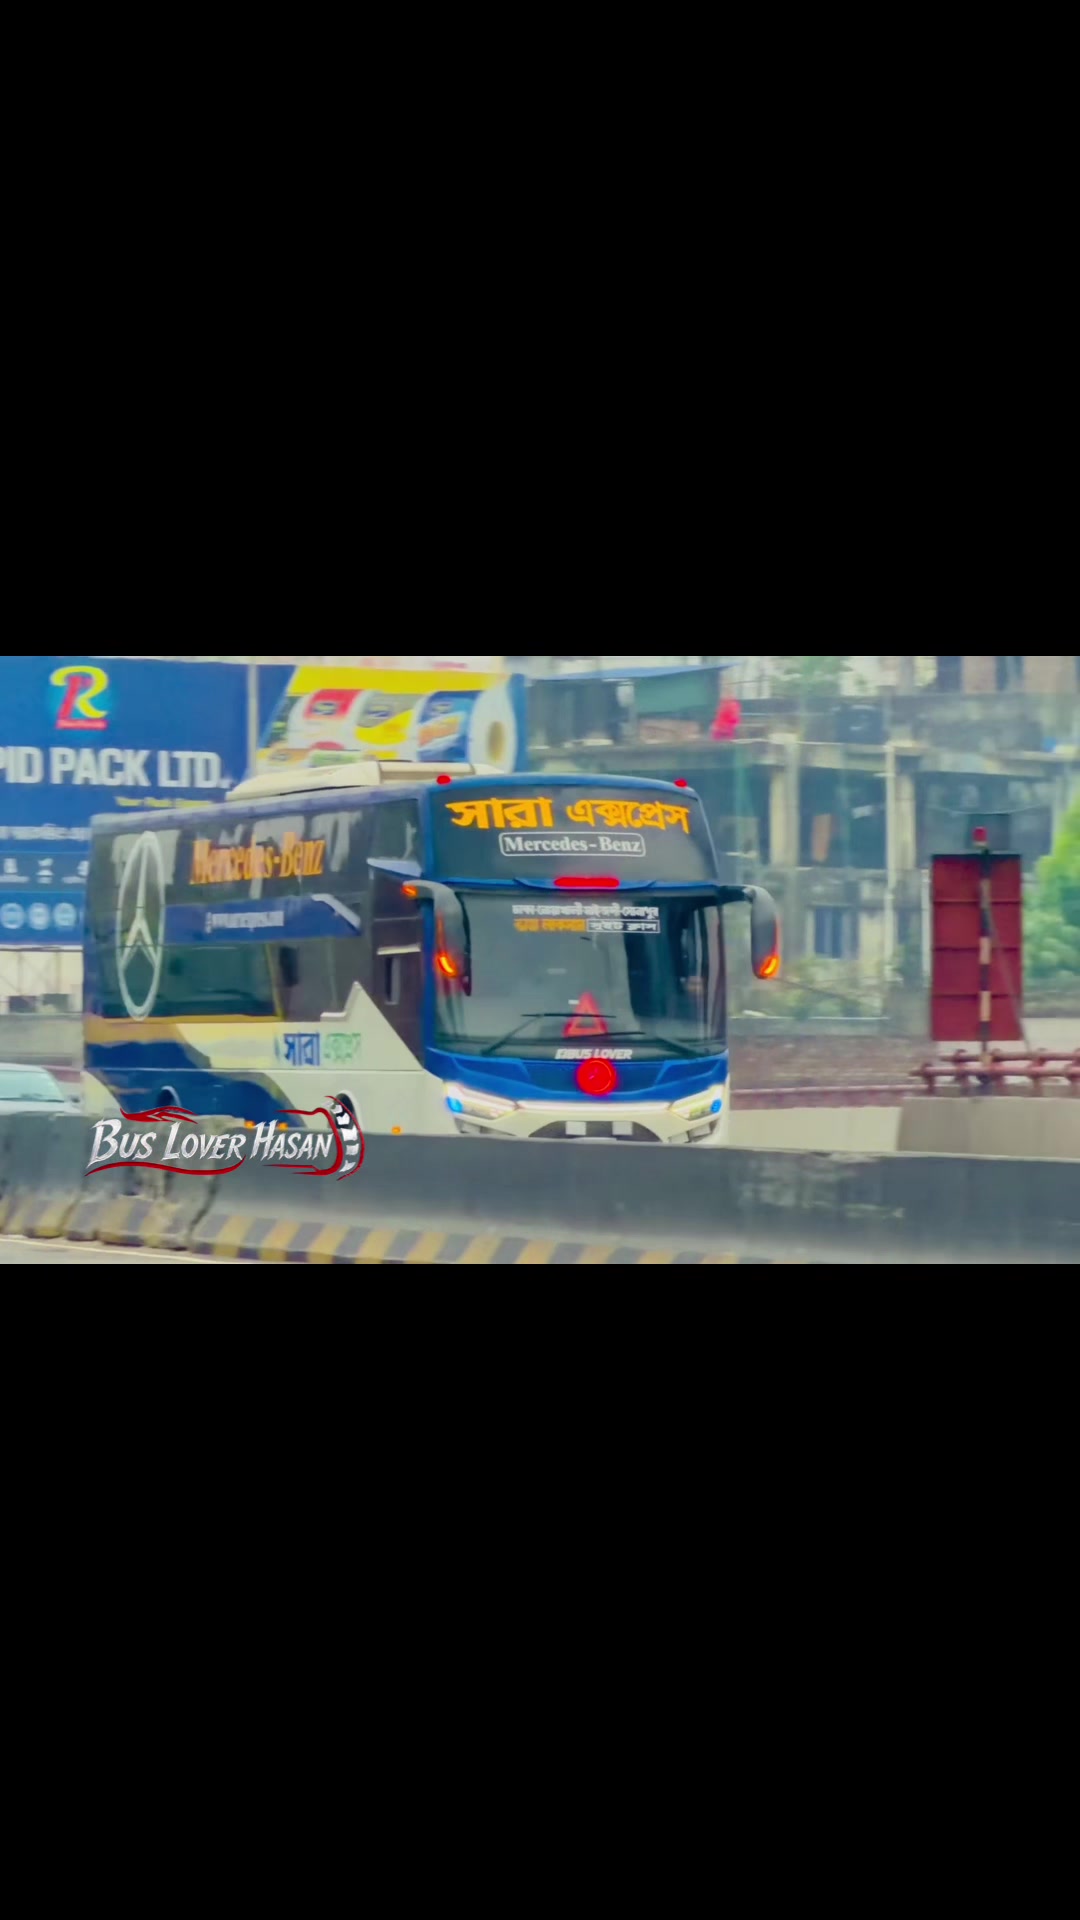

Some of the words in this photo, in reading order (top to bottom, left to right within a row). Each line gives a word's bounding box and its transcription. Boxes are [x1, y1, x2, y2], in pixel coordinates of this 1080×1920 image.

[0, 746, 44, 784] ID
[50, 747, 151, 787] PACK
[157, 750, 232, 789] LTD.
[445, 797, 553, 829] সারা
[565, 799, 690, 834] এক্সপ্রেস
[593, 1048, 633, 1060] LOVER
